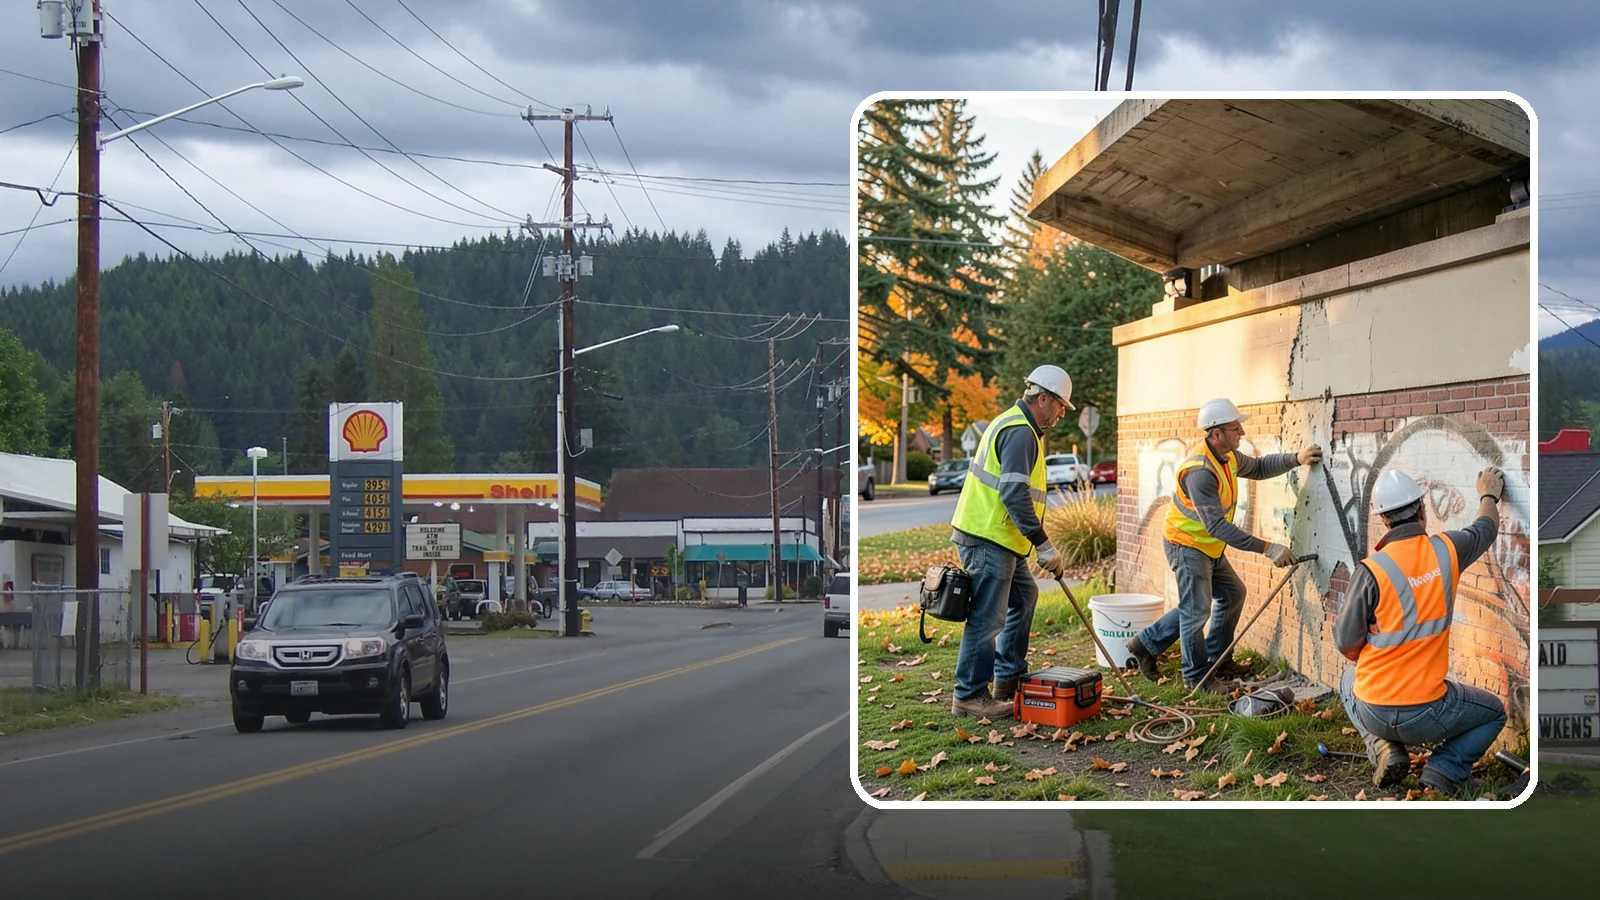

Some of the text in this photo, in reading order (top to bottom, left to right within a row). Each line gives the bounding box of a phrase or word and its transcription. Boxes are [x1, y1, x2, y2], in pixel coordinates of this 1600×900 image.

[366, 480, 383, 490] 395
[490, 484, 547, 499] Shell
[366, 494, 383, 504] 405
[366, 508, 383, 518] 415
[366, 522, 383, 533] 429
